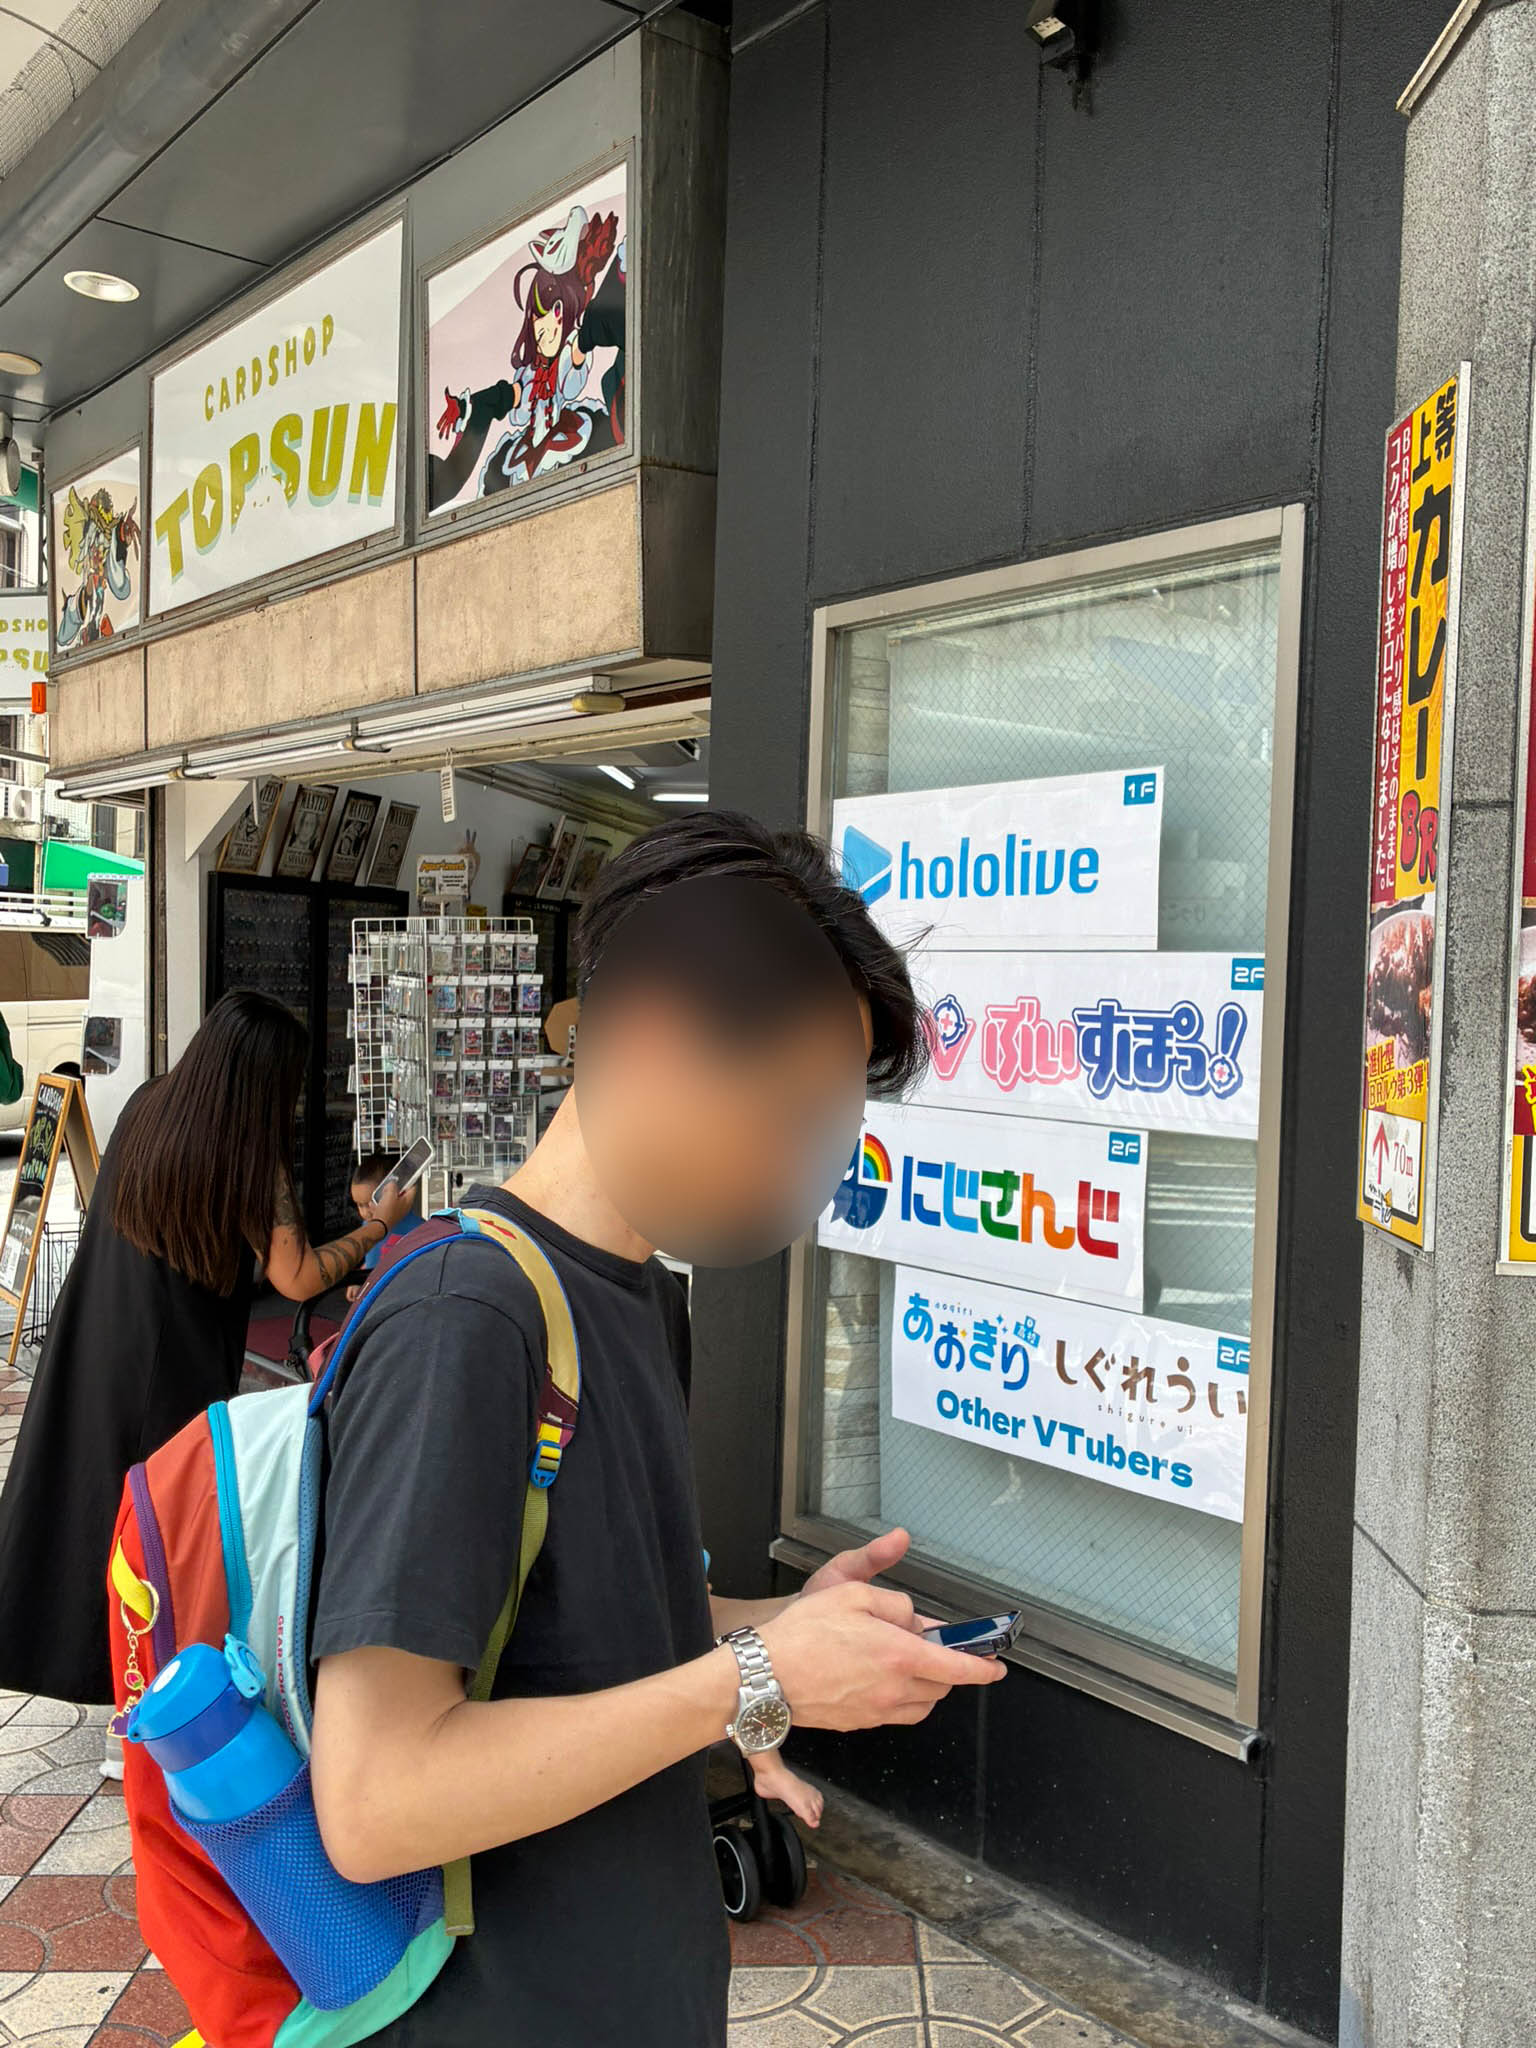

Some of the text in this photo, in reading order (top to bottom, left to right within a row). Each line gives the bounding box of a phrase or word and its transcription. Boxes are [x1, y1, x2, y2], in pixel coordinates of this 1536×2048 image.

[204, 313, 335, 421] CARDSHOP
[154, 402, 398, 584] TOPSUN
[1127, 781, 1155, 799] 1F
[900, 834, 1099, 900] hololive
[1235, 967, 1264, 984] 2F
[1110, 1140, 1139, 1157] 2F
[1393, 1142, 1414, 1178] 70m
[901, 1156, 1121, 1260] にじさんじ
[903, 1292, 1030, 1391] あおぎり
[1219, 1345, 1250, 1366] 2F
[1055, 1339, 1247, 1418] しぐれうい
[936, 1389, 1194, 1489] Other VTubers
[277, 1615, 285, 1659] GEAR
[277, 1662, 286, 1695] FOR
